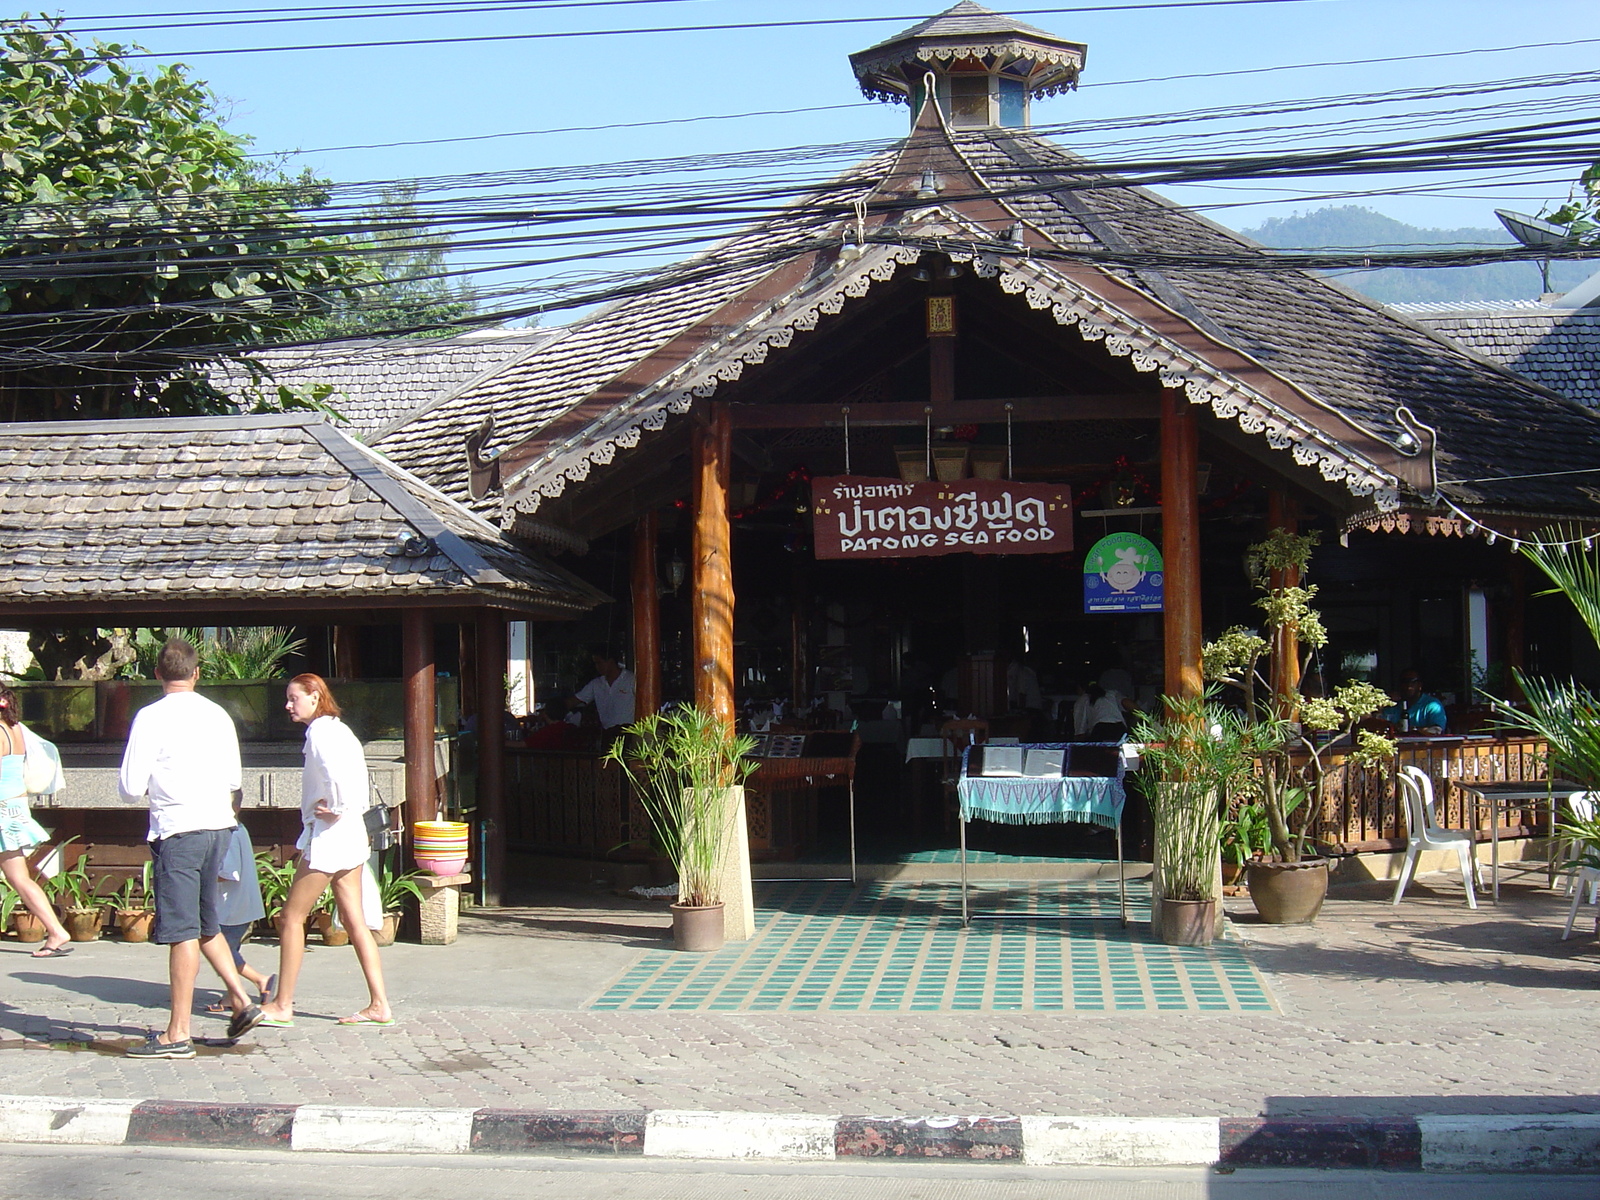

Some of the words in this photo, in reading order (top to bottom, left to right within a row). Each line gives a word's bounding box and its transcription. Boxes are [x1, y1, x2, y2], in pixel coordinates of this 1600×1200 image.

[833, 483, 914, 500] ร้านอาหาร
[841, 533, 939, 552] PATONG
[945, 530, 989, 546] SEA
[996, 527, 1055, 544] FOOD
[1086, 547, 1102, 571] Clean
[1101, 535, 1122, 549] Food
[1125, 535, 1148, 550] Good
